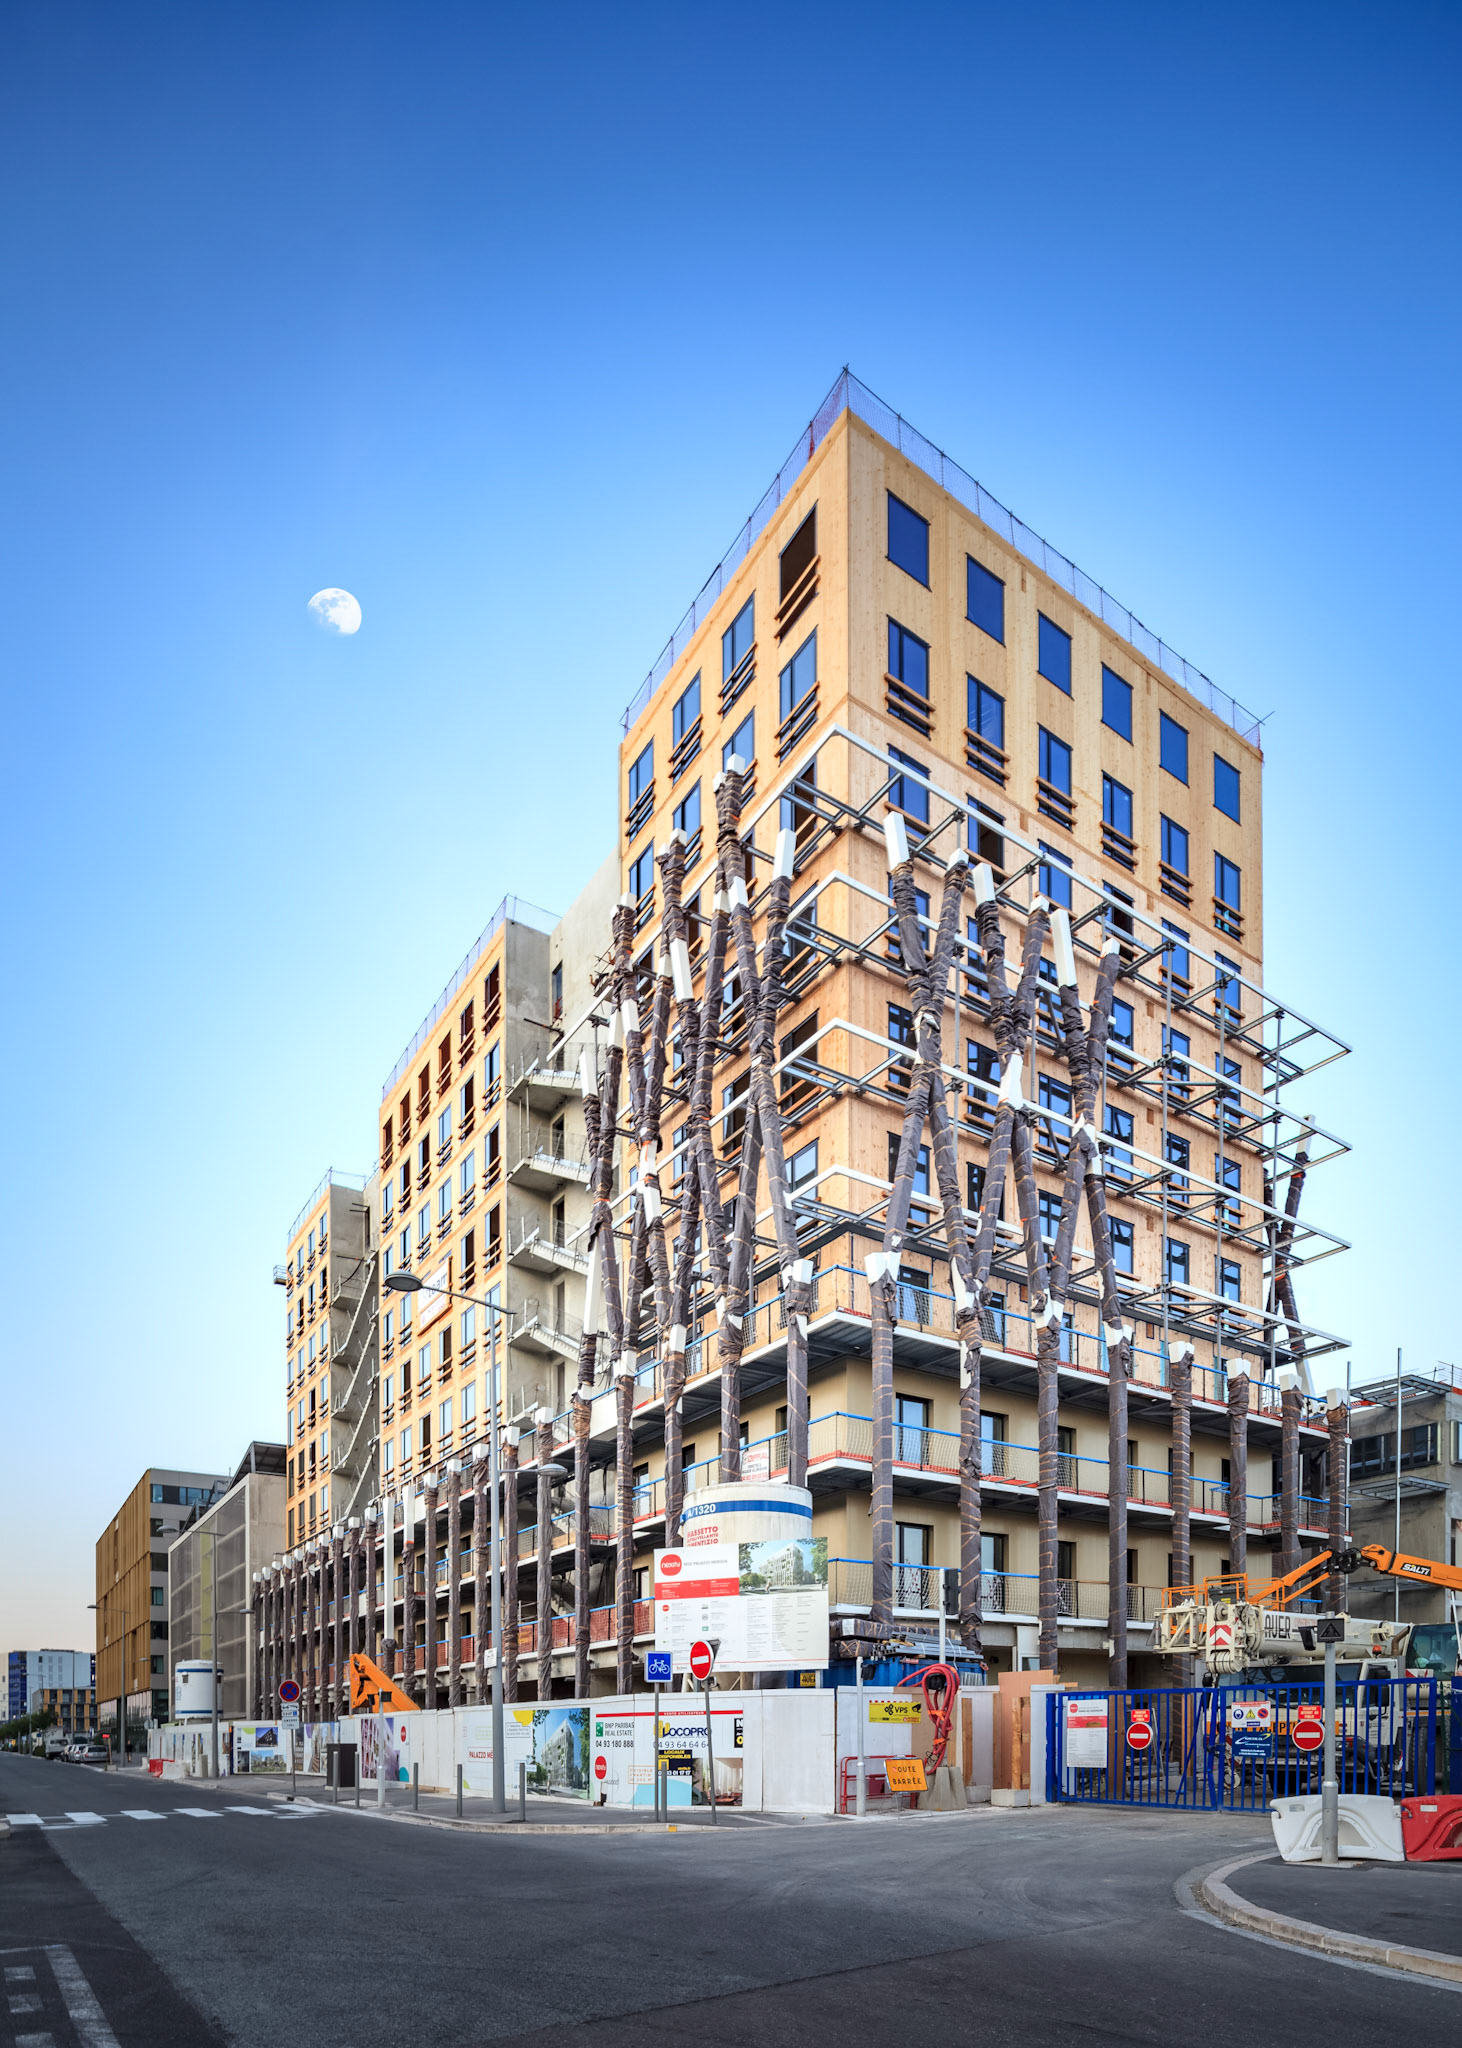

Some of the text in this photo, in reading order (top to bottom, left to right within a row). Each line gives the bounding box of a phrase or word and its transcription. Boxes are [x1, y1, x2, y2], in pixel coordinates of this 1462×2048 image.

[687, 1503, 716, 1518] A/1320
[1402, 1563, 1430, 1575] SALTI
[1264, 1614, 1291, 1639] AUER
[596, 1740, 634, 1748] 04 93 180 888
[664, 1741, 675, 1749] 93
[677, 1741, 687, 1749] 64
[689, 1741, 699, 1749] 64
[469, 1751, 486, 1759] PALAZZO
